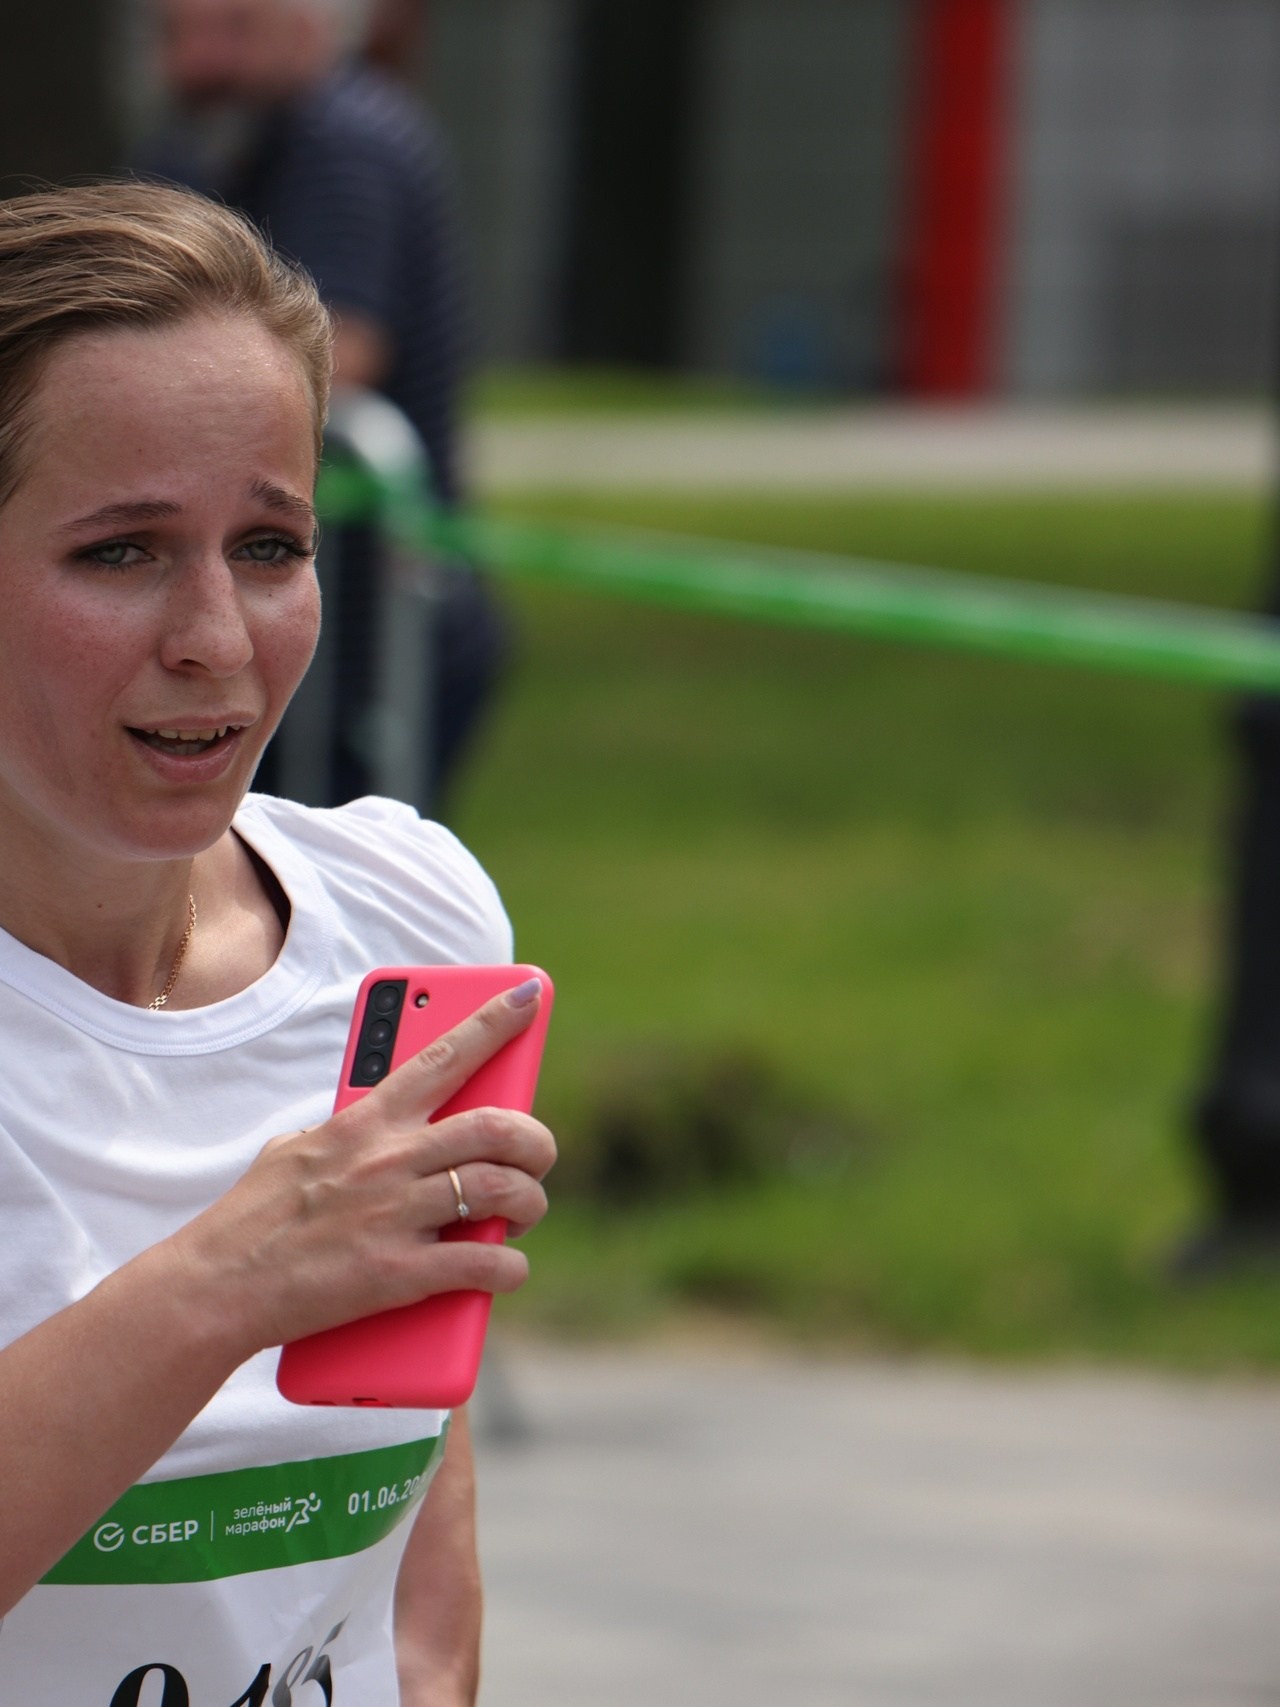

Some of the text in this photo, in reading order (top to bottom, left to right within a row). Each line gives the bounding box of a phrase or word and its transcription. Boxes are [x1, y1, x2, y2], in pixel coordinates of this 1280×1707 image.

[233, 1497, 292, 1520] зелёный
[132, 1519, 199, 1545] СБЕР
[225, 1515, 286, 1536] марафон
